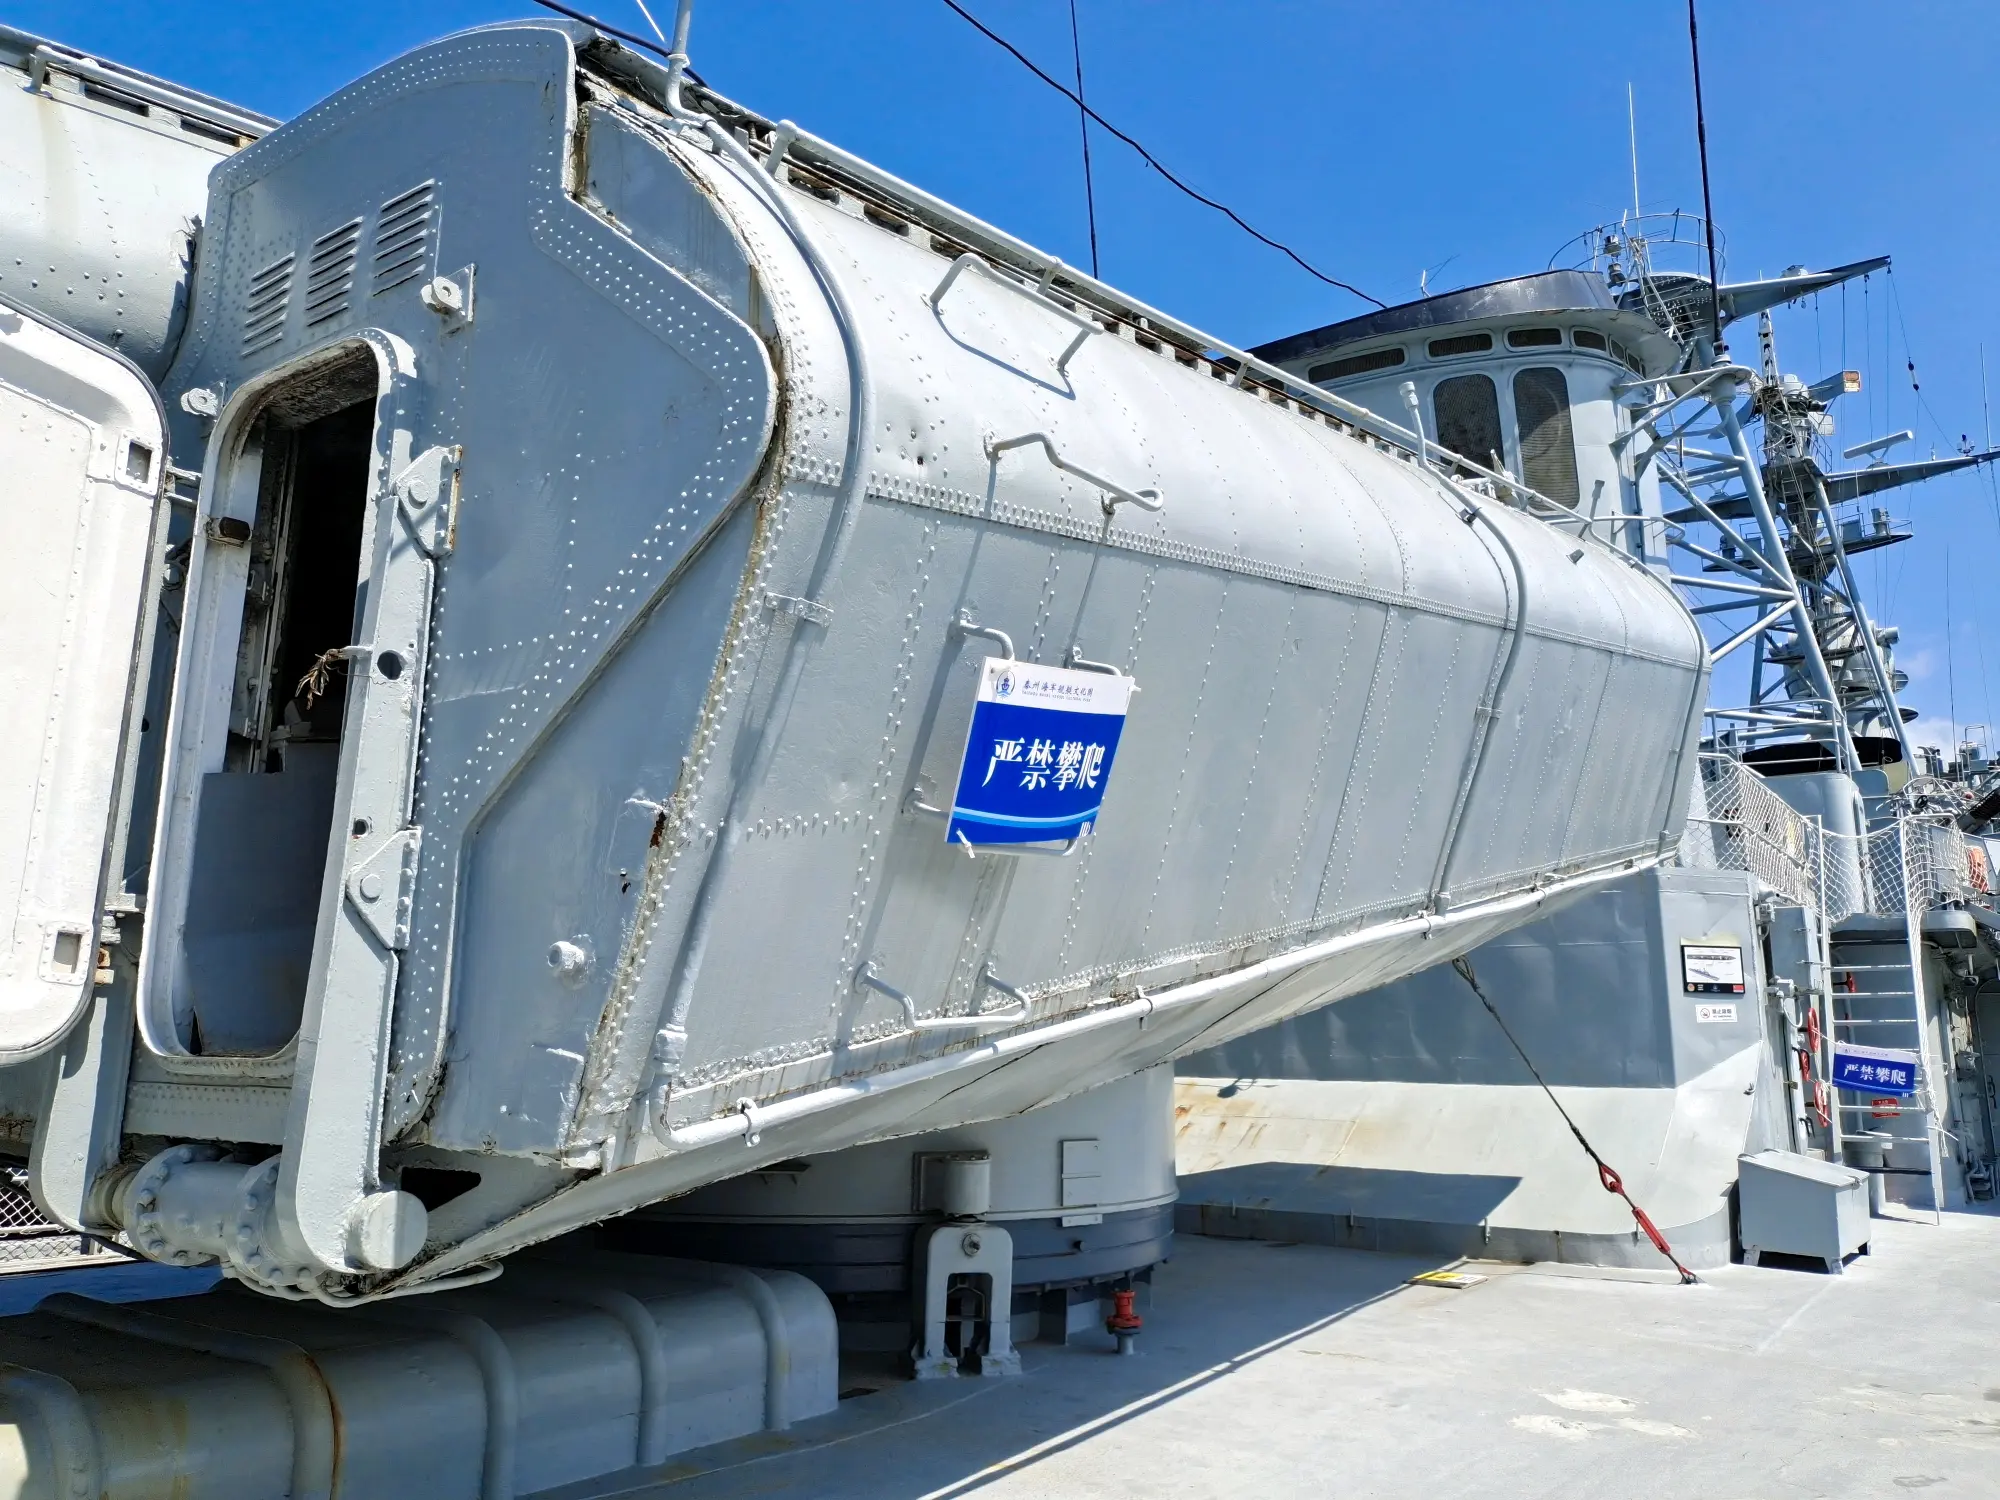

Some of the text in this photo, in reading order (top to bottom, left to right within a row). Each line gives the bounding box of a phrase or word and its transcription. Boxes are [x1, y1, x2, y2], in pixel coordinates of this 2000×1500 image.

[982, 737, 1106, 791] 严禁攀爬
[1843, 1063, 1907, 1086] 严禁攀爬
